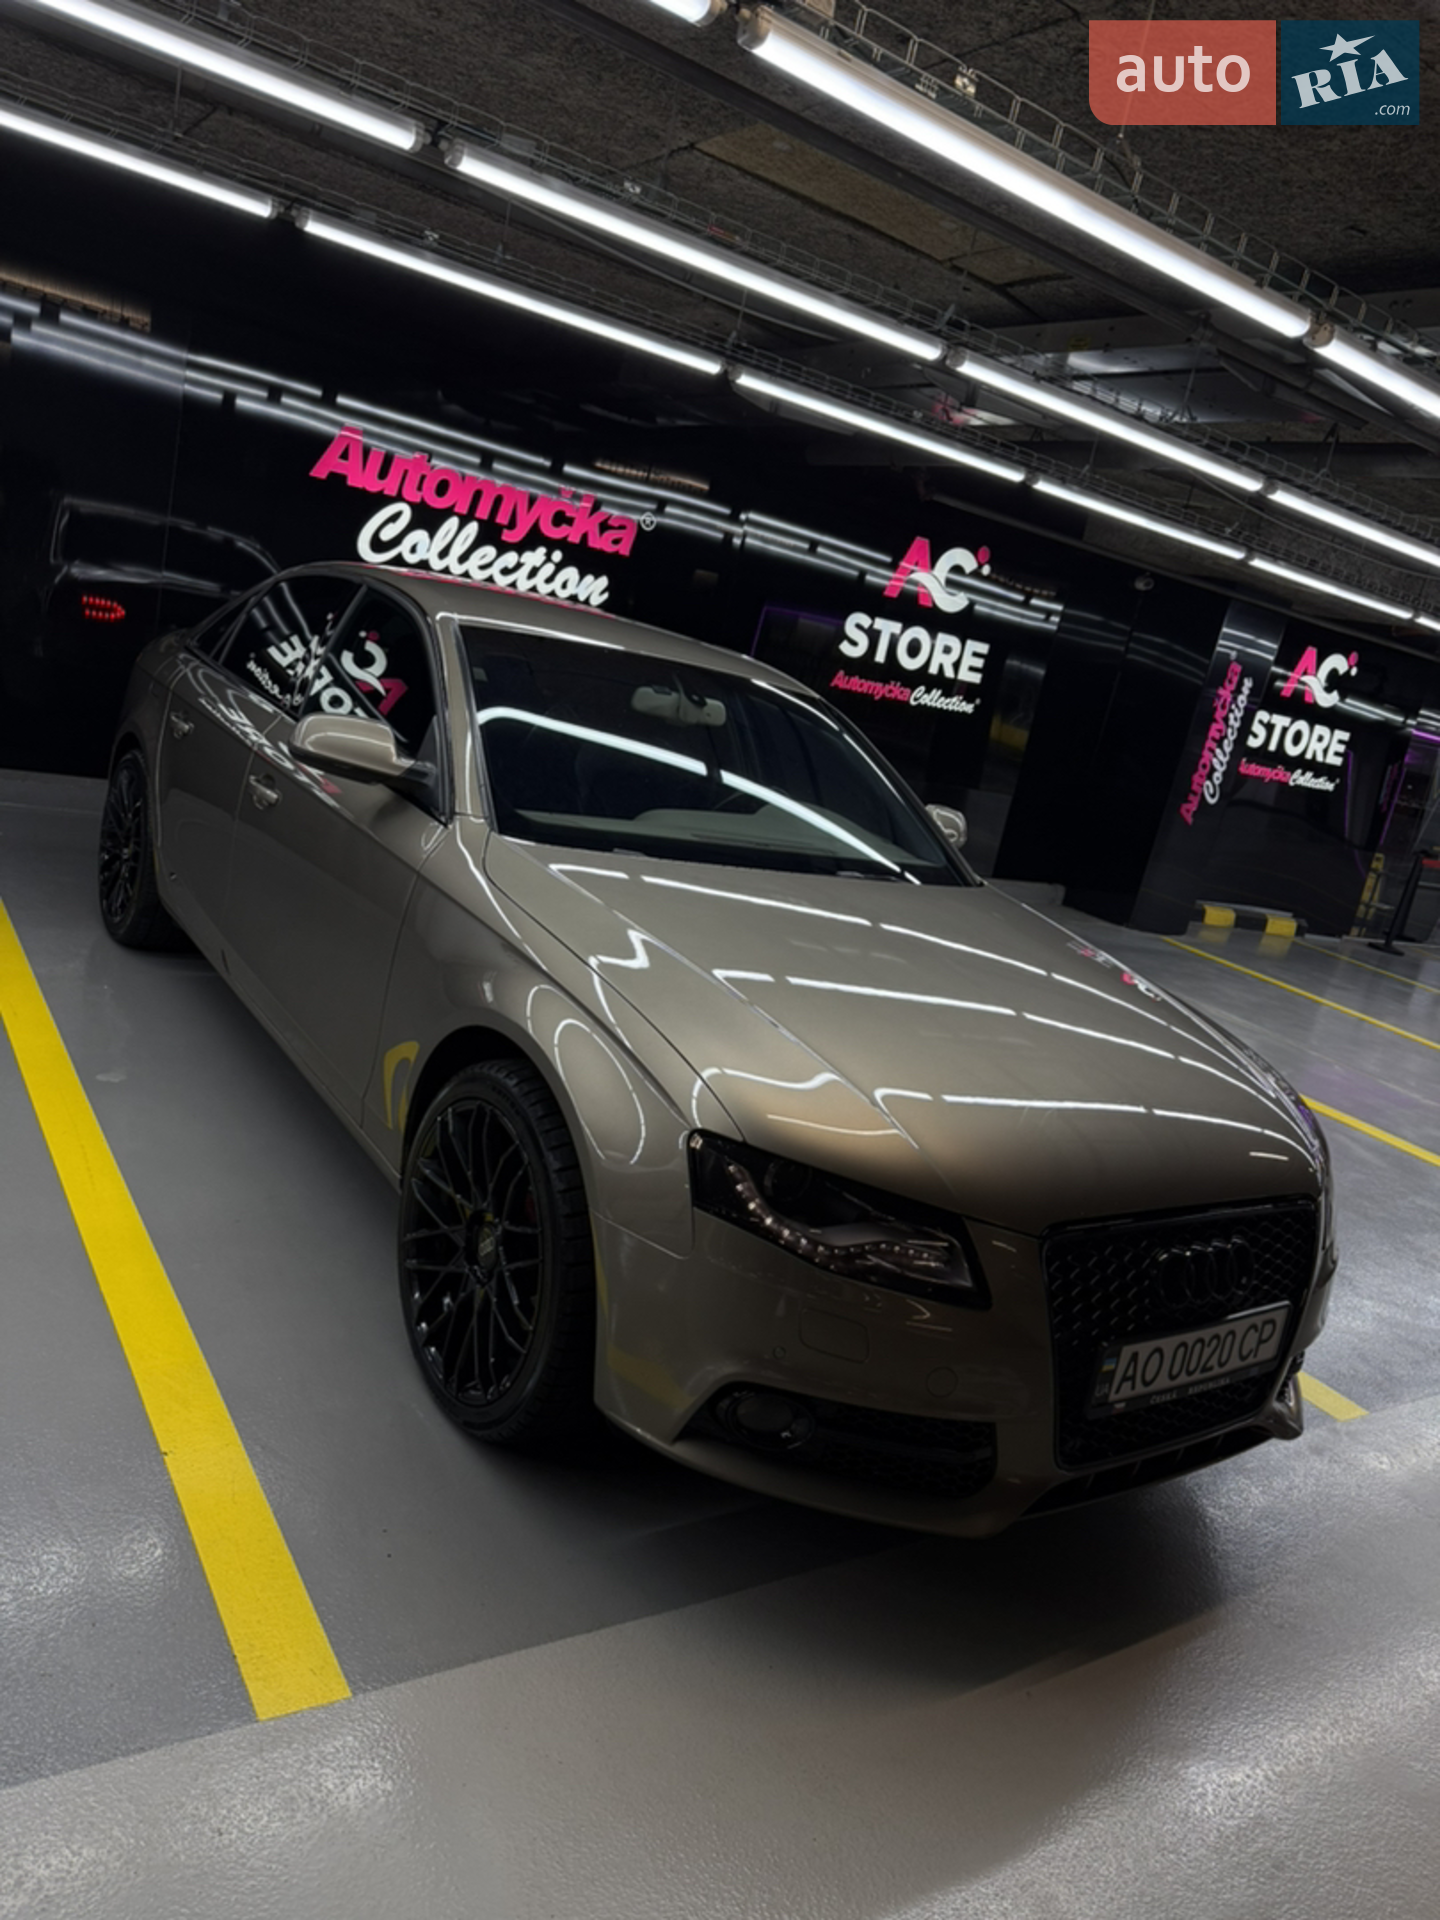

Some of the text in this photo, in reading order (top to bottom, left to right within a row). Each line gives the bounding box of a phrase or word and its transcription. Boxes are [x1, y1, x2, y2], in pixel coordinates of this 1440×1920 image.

[309, 422, 638, 557] Automyčka
[356, 502, 609, 606] Collection
[838, 611, 990, 684] STORE
[909, 685, 976, 714] Collection
[1246, 709, 1351, 766] STORE
[1203, 676, 1254, 805] Collection
[1115, 1318, 1277, 1395] AO 0020 CP
